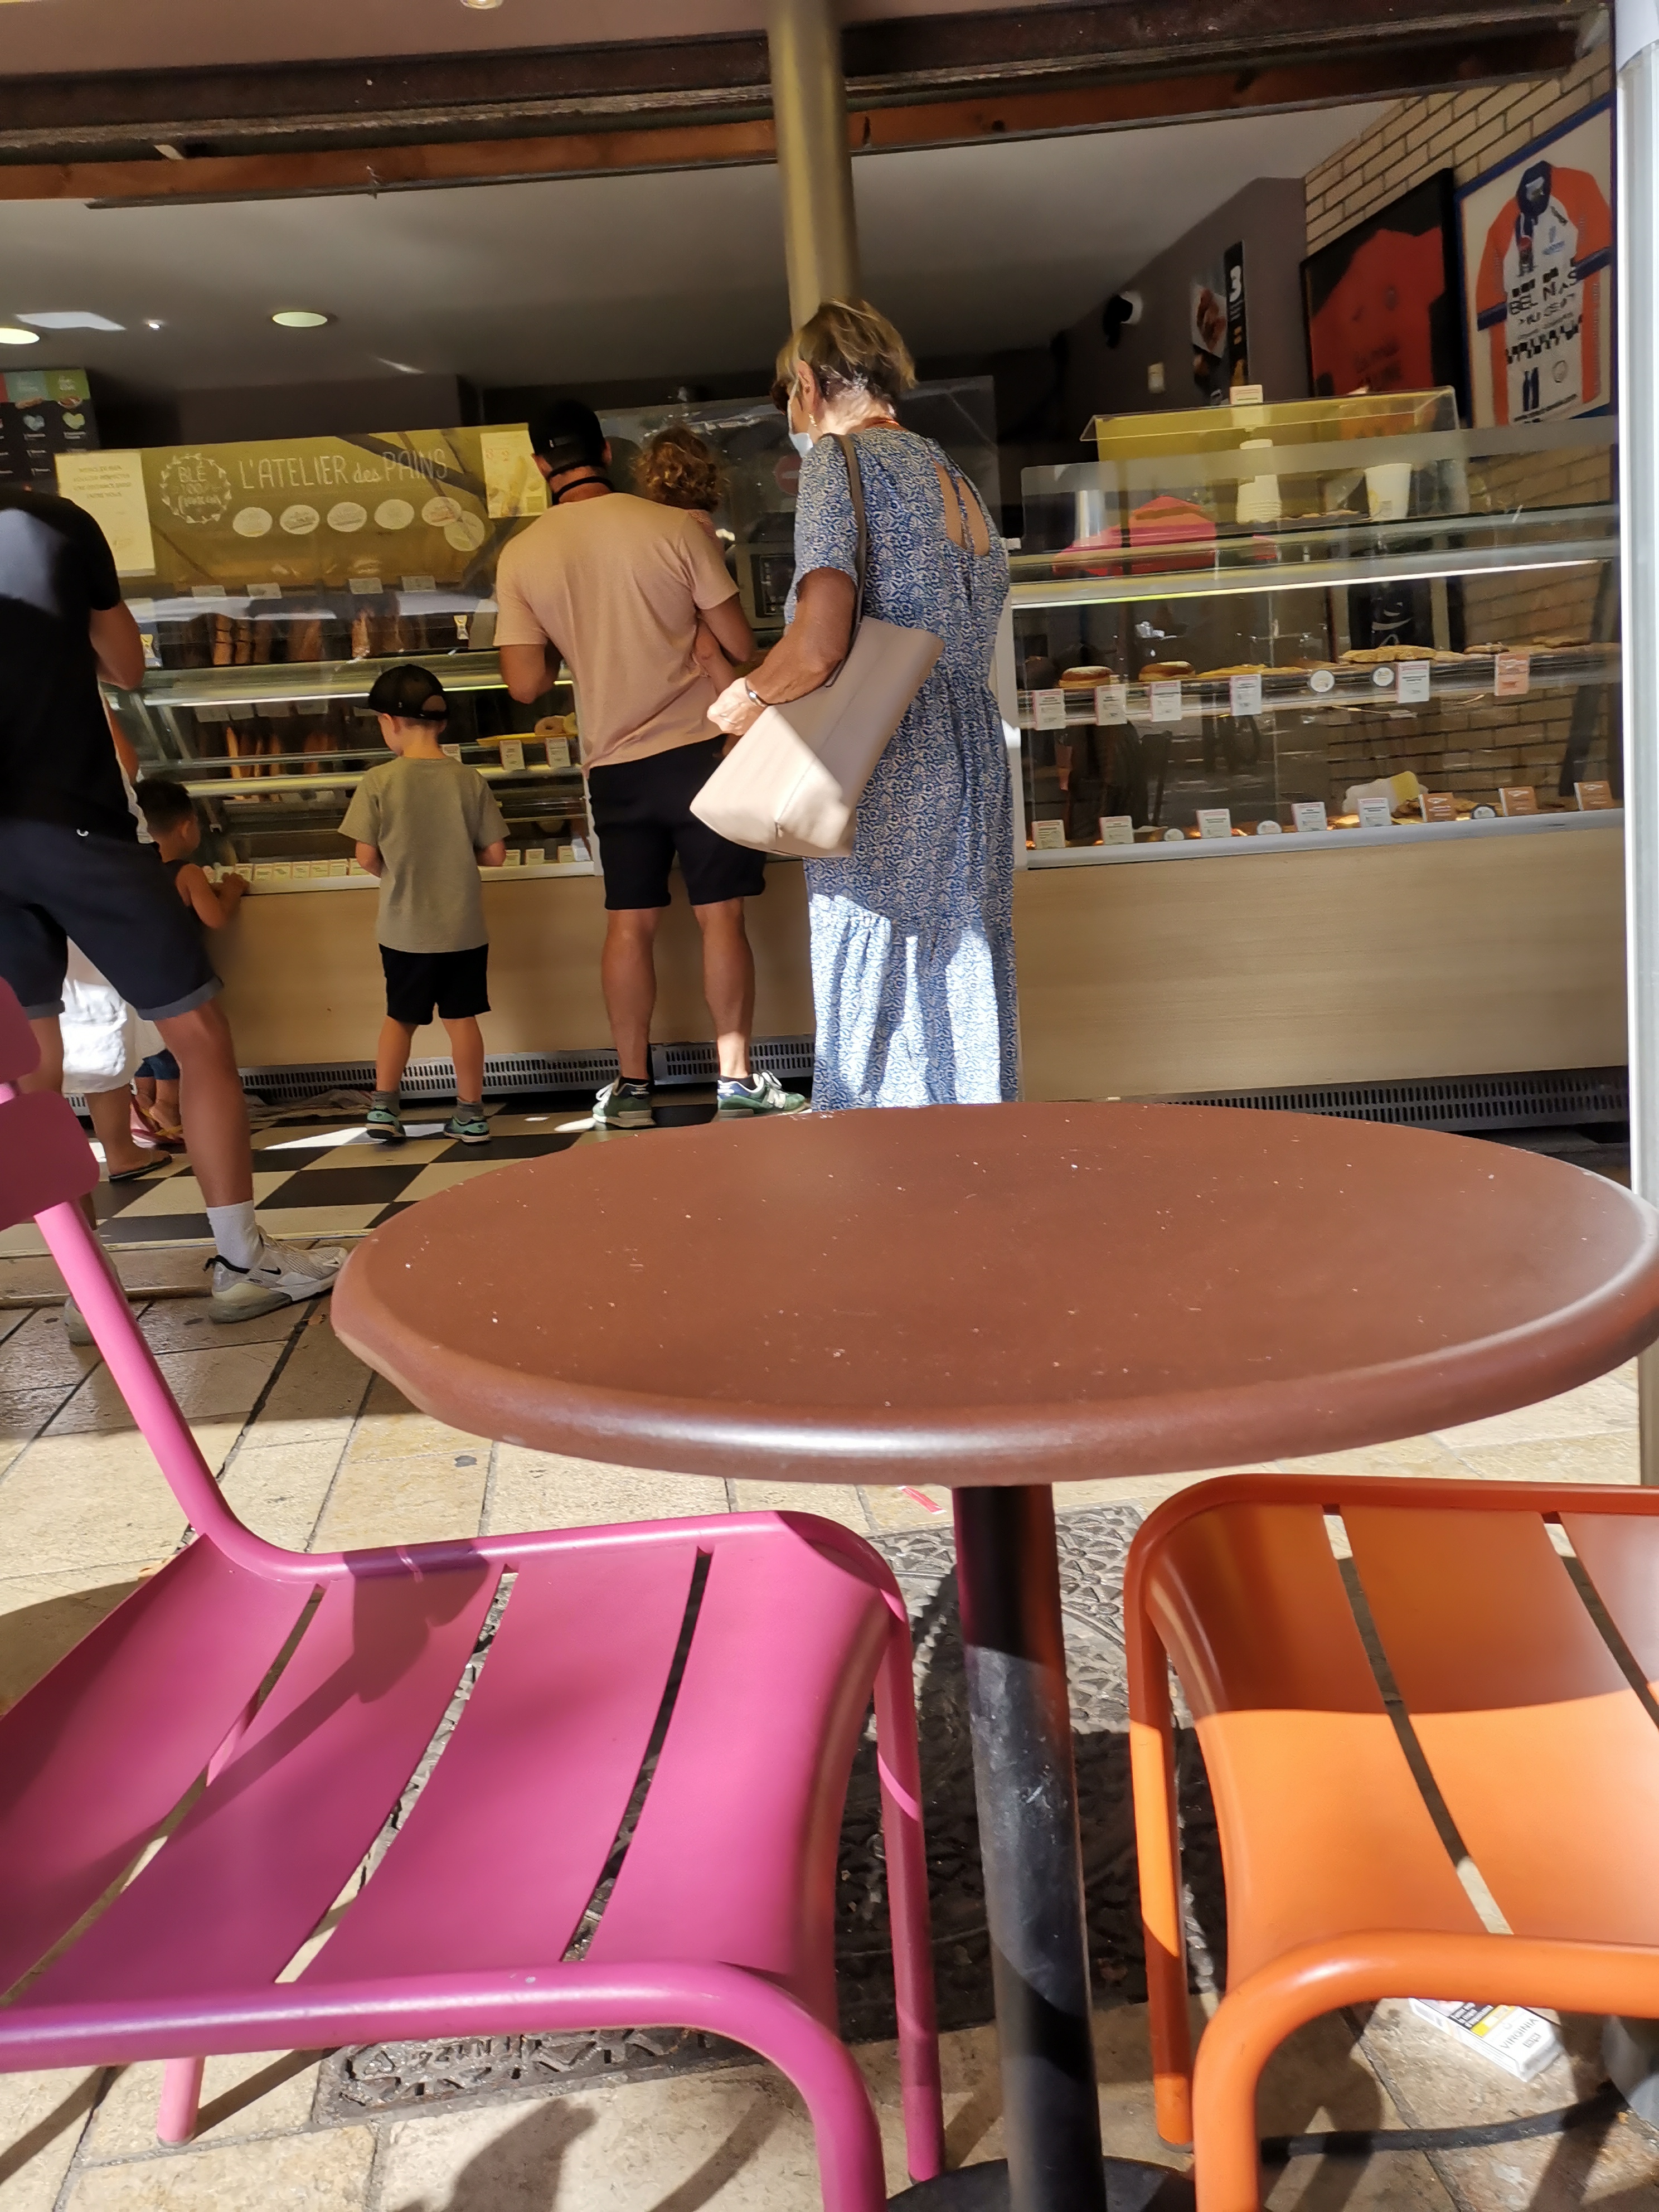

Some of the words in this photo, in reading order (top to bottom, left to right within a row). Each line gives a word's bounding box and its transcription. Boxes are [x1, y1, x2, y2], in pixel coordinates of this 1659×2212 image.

[239, 454, 349, 489] L'ATELIER
[353, 462, 384, 484] des
[382, 448, 448, 481] PAINS
